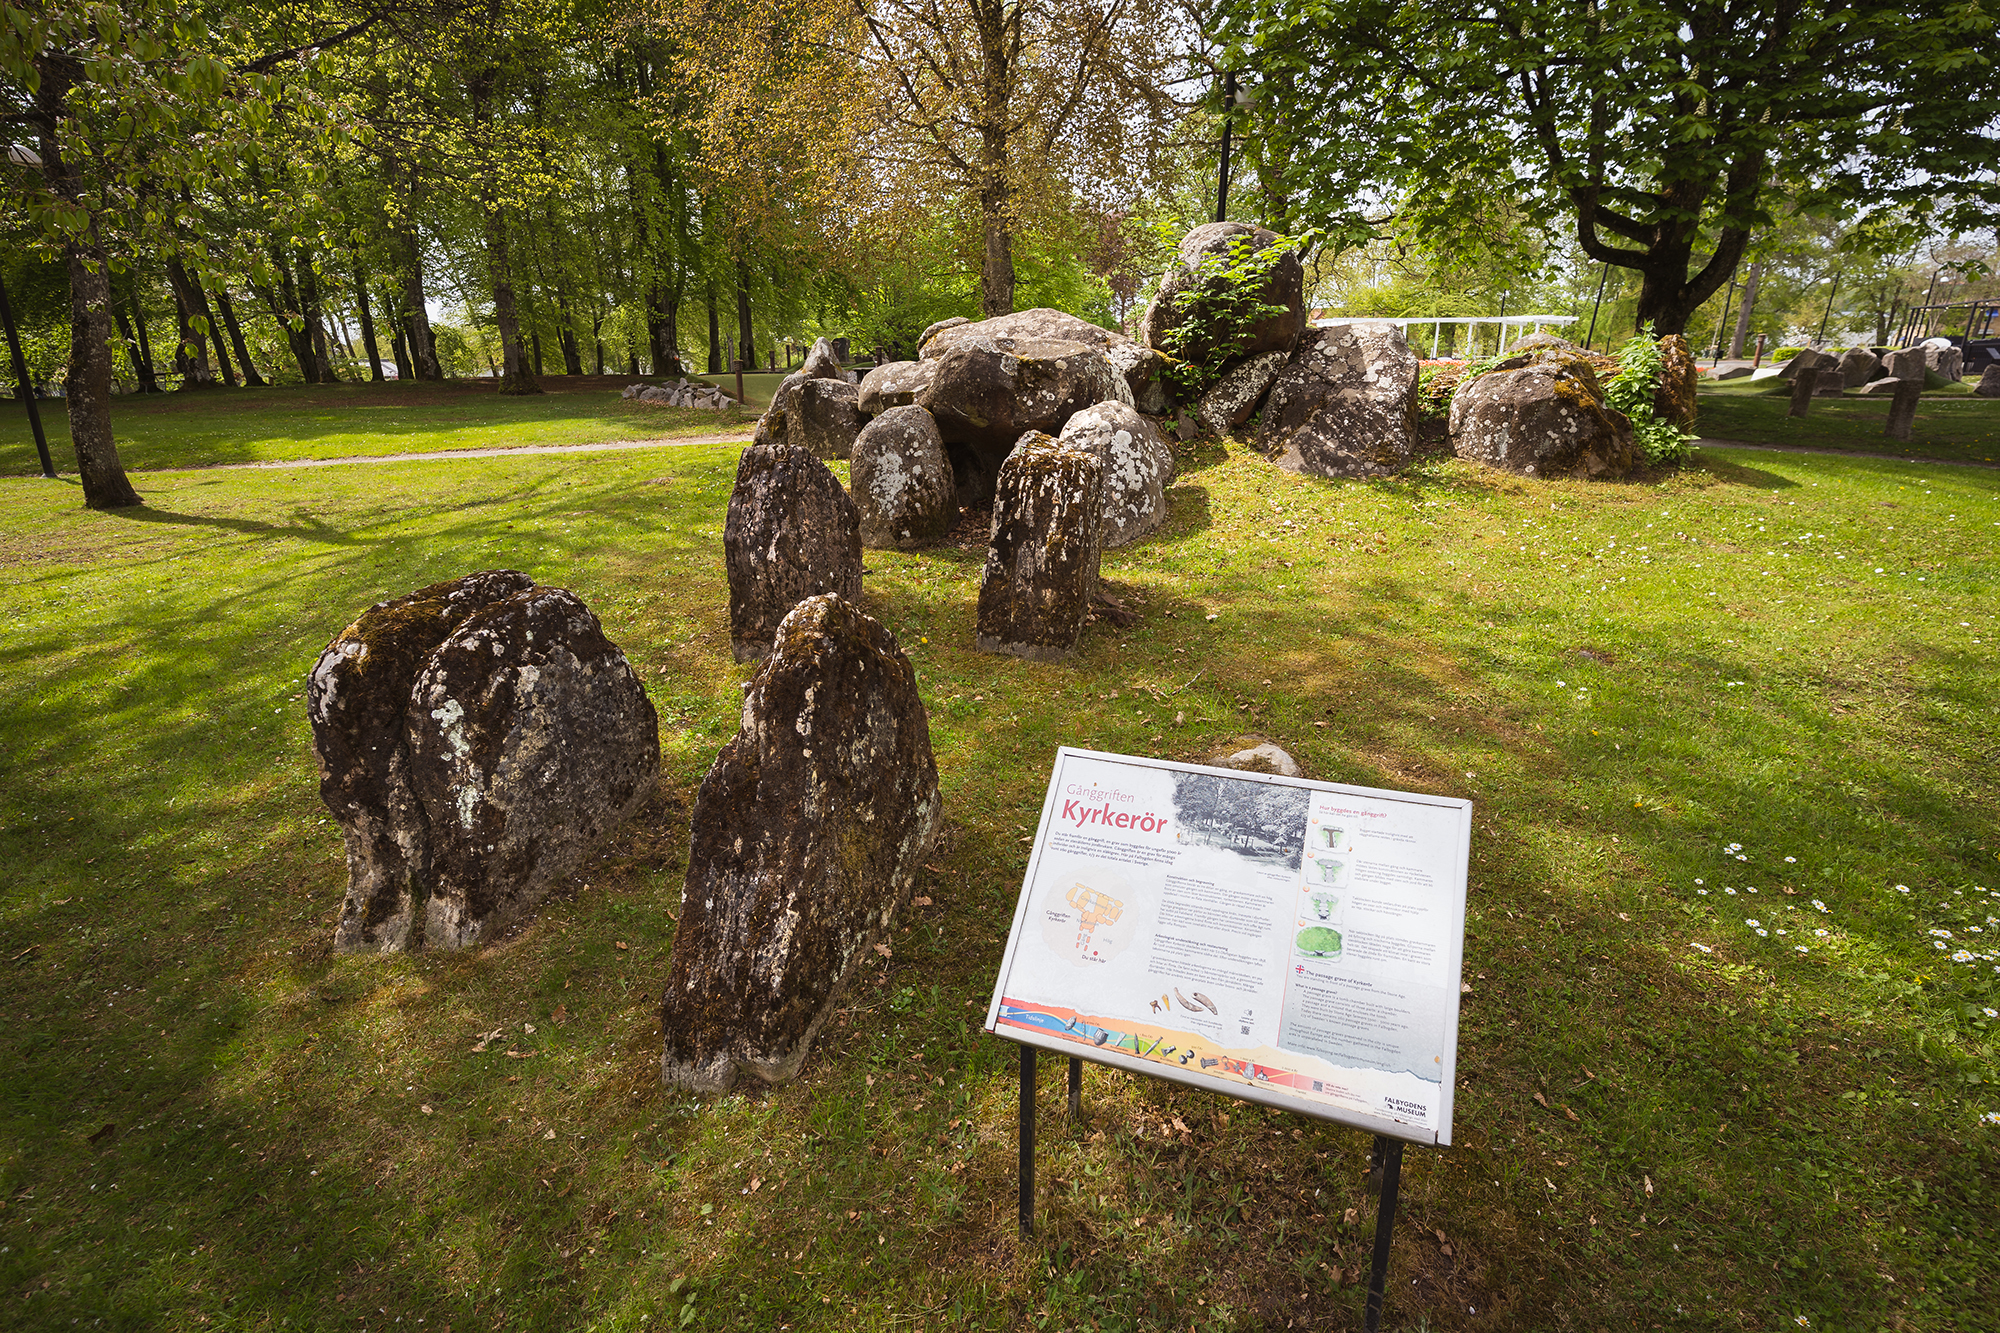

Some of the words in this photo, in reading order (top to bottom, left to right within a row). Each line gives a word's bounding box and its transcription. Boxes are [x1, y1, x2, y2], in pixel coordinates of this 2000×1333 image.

[1066, 783, 1135, 803] Gånggriften
[1061, 799, 1168, 834] Kyrkerör
[1025, 1014, 1043, 1024] Tidslinje
[1384, 1096, 1427, 1111] FALBYGDENS
[1396, 1106, 1426, 1118] MUSEUM
